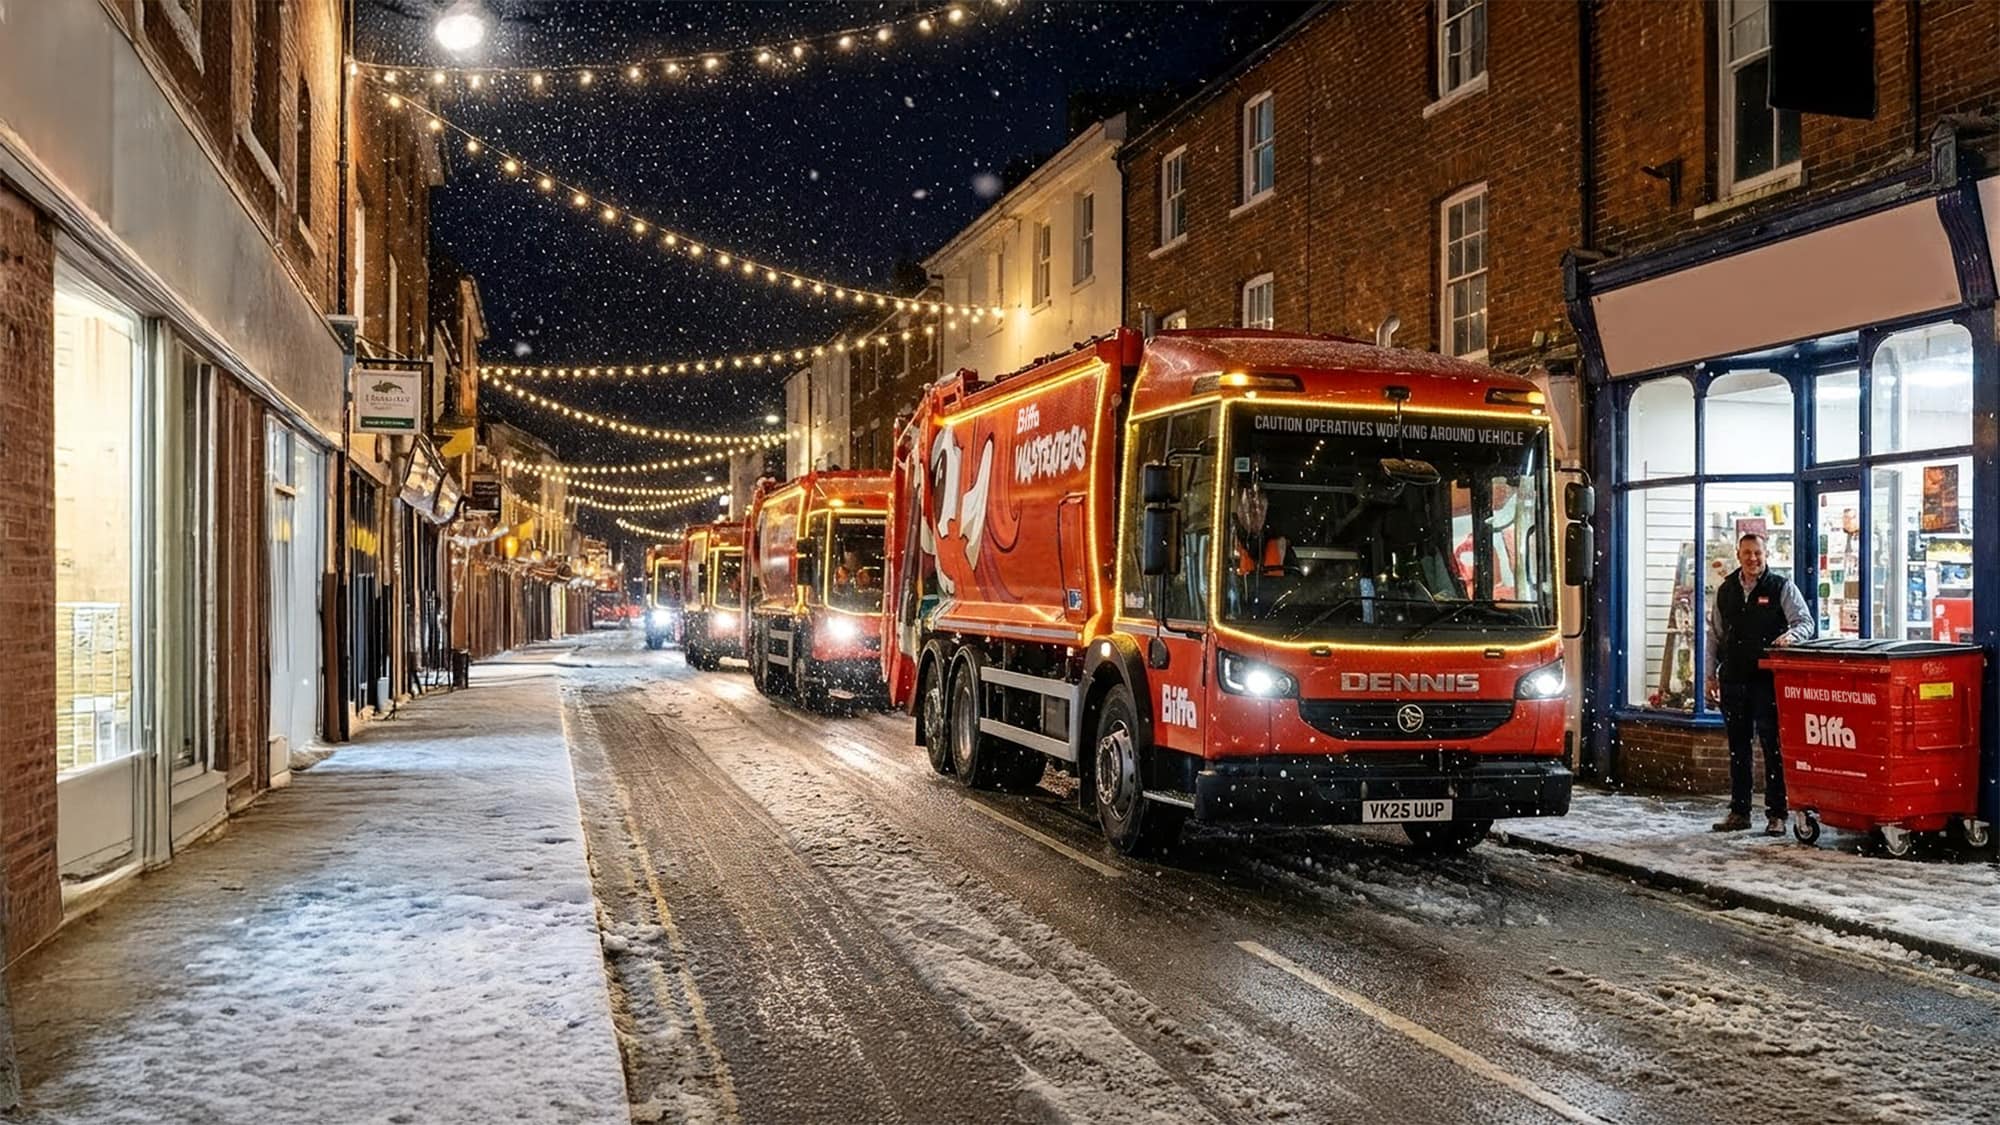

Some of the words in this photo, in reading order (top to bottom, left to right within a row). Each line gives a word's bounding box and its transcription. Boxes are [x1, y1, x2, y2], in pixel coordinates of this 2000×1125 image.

[1016, 402, 1040, 434] Biffa
[1254, 415, 1303, 432] CAUTION
[1305, 418, 1373, 437] OPERATIVES
[1430, 425, 1476, 442] AROUND
[1478, 429, 1524, 446] VEHICLE
[1340, 672, 1480, 692] DENNIS
[1784, 686, 1801, 698] DRY
[1803, 687, 1830, 702] MIXED
[1831, 690, 1877, 705] RECYCLING
[1162, 683, 1197, 728] Biffa
[1805, 713, 1857, 749] Biffa
[1370, 802, 1411, 818] VK25
[1414, 802, 1444, 818] UUP
